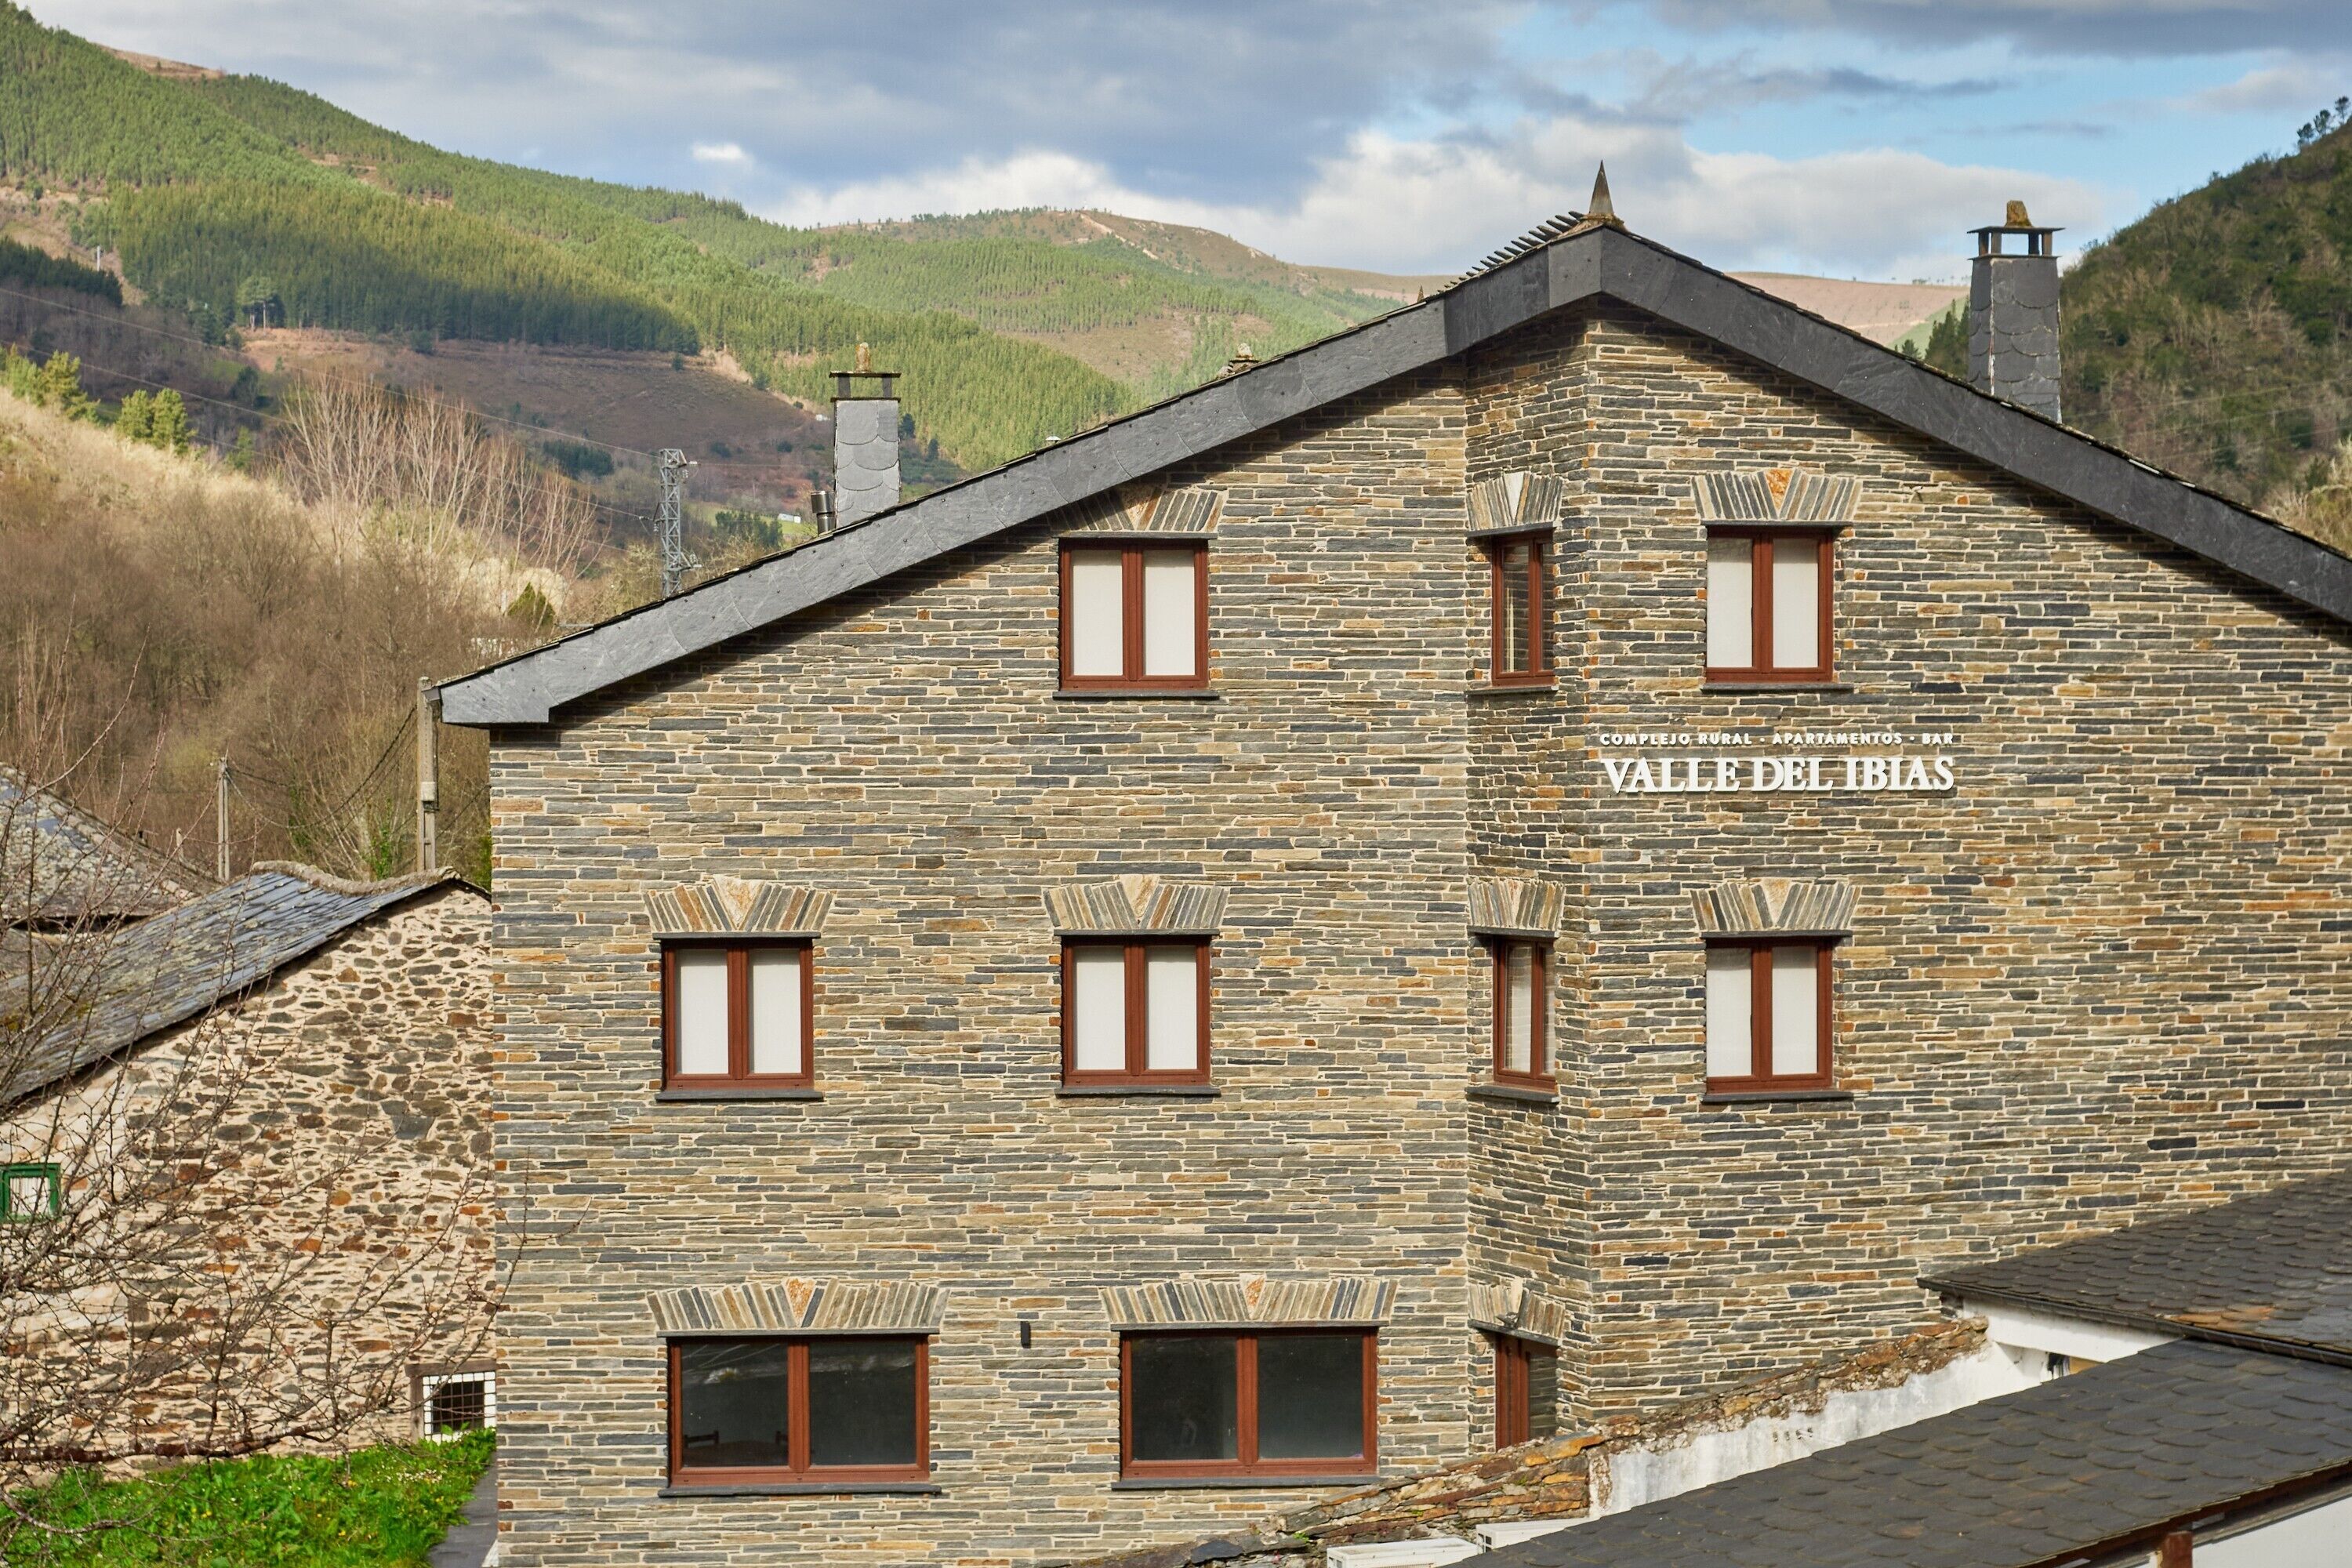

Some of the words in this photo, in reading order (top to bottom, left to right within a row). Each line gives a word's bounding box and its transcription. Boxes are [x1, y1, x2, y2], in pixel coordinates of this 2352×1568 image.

[1599, 733, 1690, 745] COMPLEJO
[1698, 733, 1752, 745] RURAL
[1772, 732, 1903, 745] APARTAMENTOS
[1922, 732, 1954, 745] BAR
[1600, 757, 1740, 793] VALLE
[1751, 757, 1834, 792] DEL
[1843, 756, 1955, 791] IBIAS
